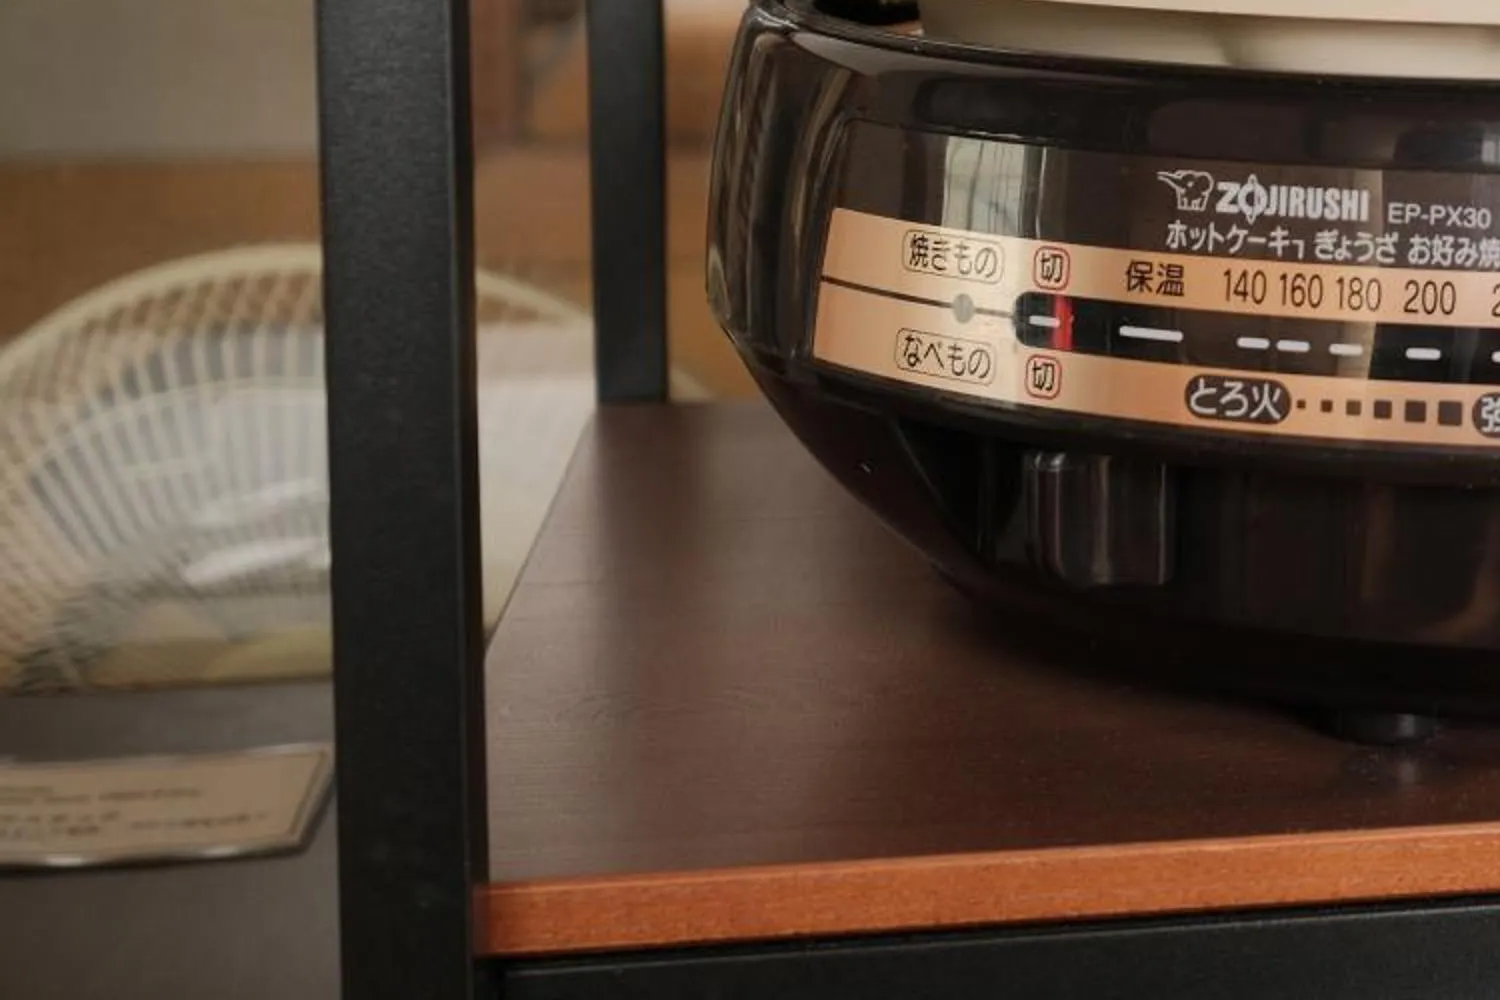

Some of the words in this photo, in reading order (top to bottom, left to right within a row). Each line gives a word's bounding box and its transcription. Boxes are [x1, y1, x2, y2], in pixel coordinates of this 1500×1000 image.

[1215, 174, 1370, 225] ZOJIRUSHI
[1388, 203, 1492, 230] EP-PX30
[908, 233, 998, 279] 焼きもの
[1166, 220, 1294, 258] ホットケーキ
[1315, 230, 1400, 265] ぎょうざ
[1039, 252, 1063, 284] 切
[1126, 259, 1186, 298] 保温
[1223, 270, 1267, 305] 140
[1279, 273, 1324, 309] 160
[1336, 277, 1382, 313] 180
[1403, 280, 1457, 316] 200
[904, 334, 991, 380] なべもの
[1031, 361, 1055, 392] 切
[1188, 378, 1284, 418] とろ火
